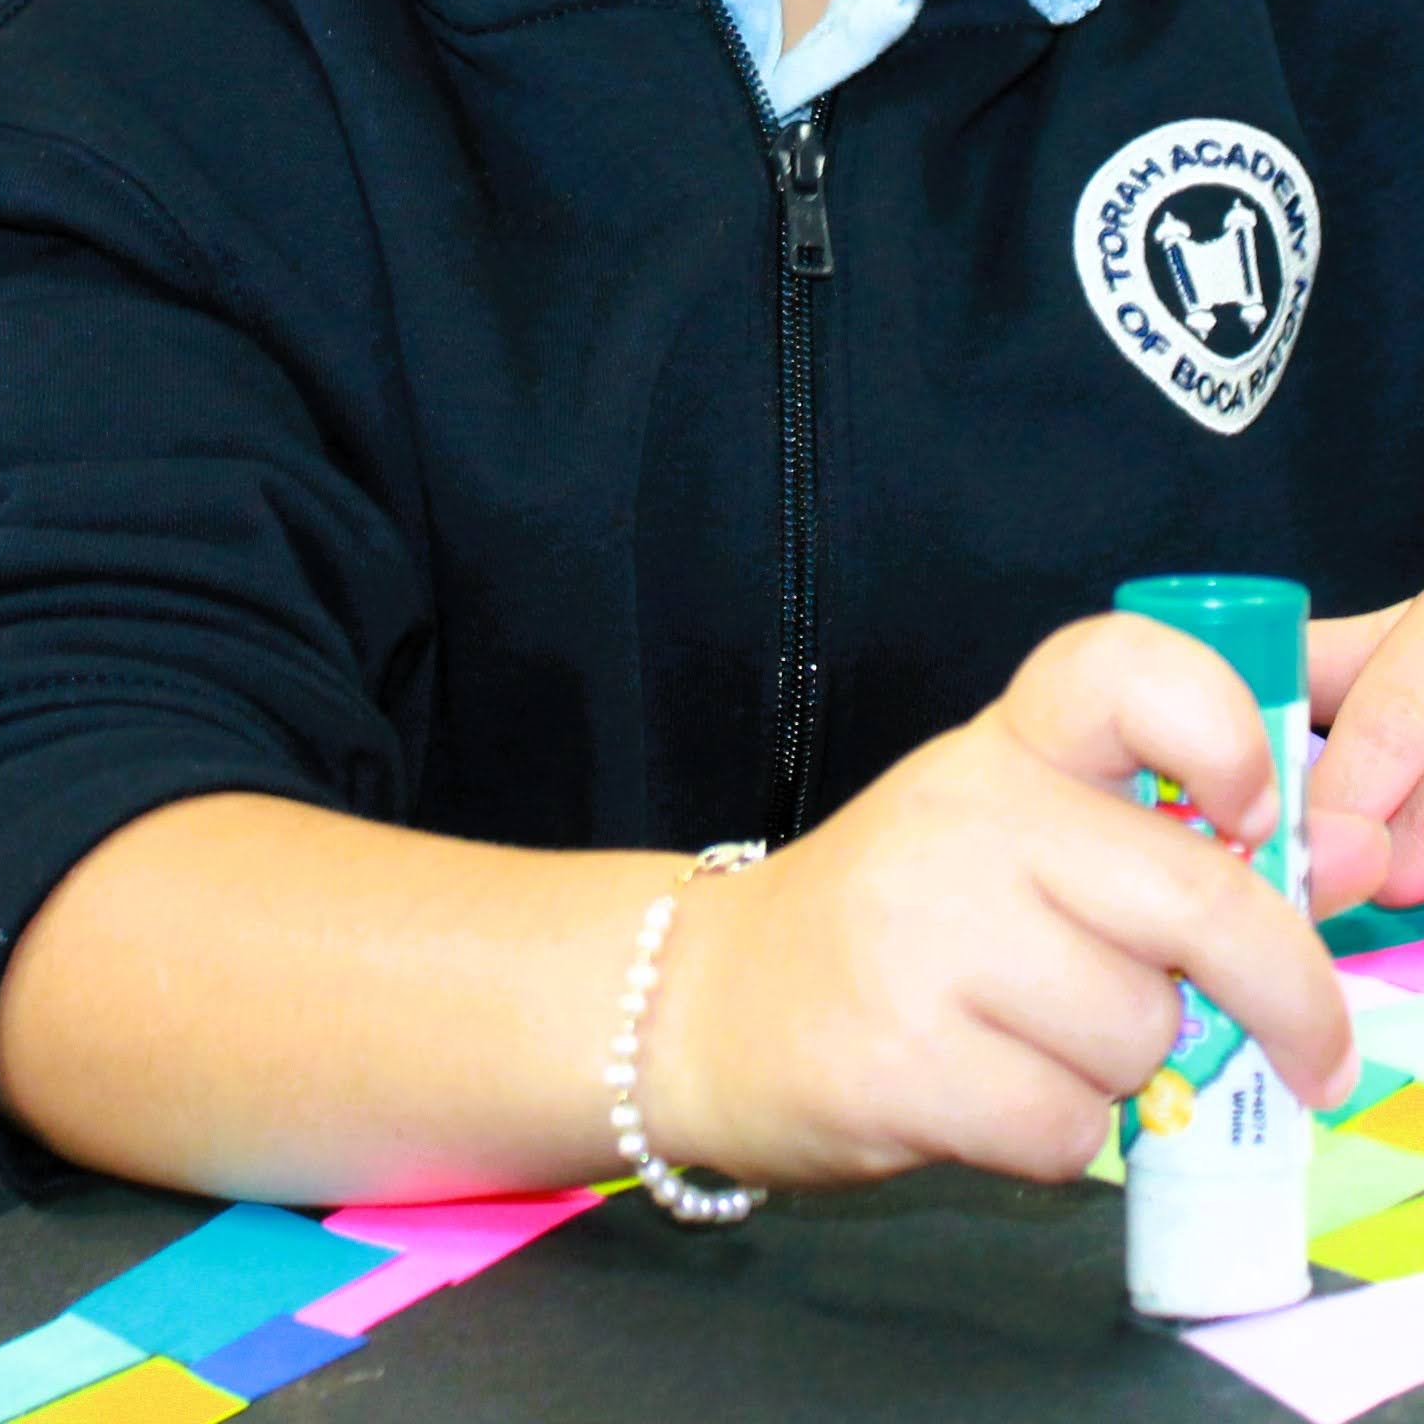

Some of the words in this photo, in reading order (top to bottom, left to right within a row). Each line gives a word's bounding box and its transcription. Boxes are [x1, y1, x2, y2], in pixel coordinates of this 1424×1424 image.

[1098, 158, 1166, 291] TORAH
[1171, 139, 1307, 260] ACADEMY
[1117, 303, 1171, 355] OF
[1171, 356, 1245, 415] BOCA
